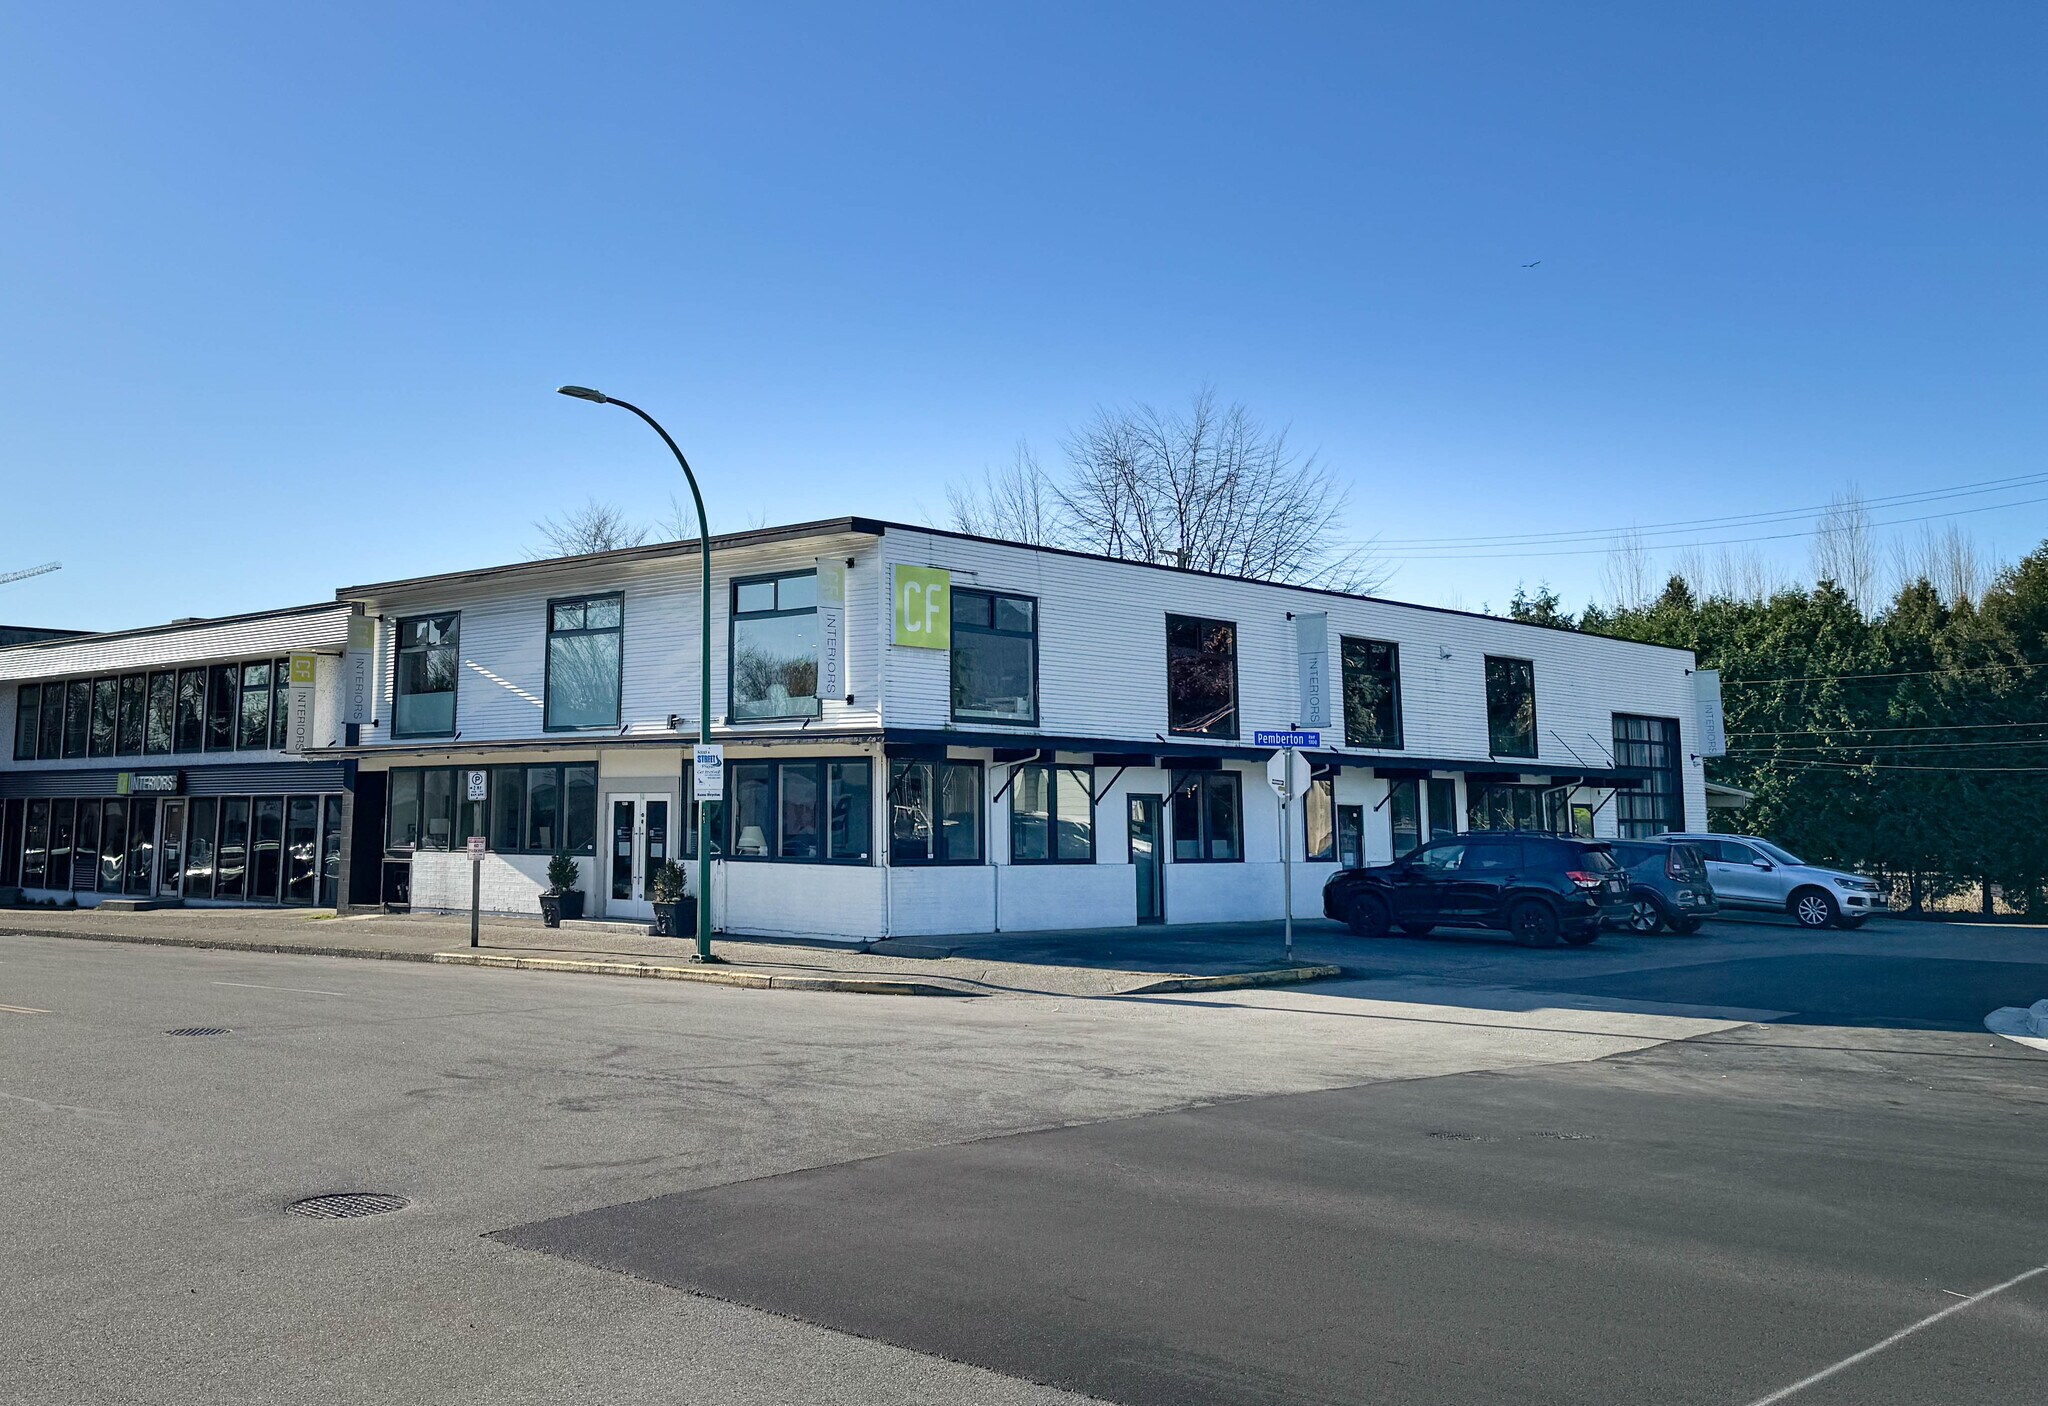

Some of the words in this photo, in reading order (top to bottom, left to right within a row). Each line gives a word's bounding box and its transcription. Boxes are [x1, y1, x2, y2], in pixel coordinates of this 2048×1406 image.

[903, 580, 942, 634] CF
[295, 660, 310, 678] CF
[826, 613, 837, 694] INTERIORS
[353, 658, 364, 720] INTERIORS
[1308, 657, 1320, 723] INTERIORS
[295, 691, 306, 751] INTERIORS
[1257, 733, 1304, 745] Pemberton
[1704, 704, 1717, 755] INTERIORS
[129, 773, 177, 791] INTERIORS
